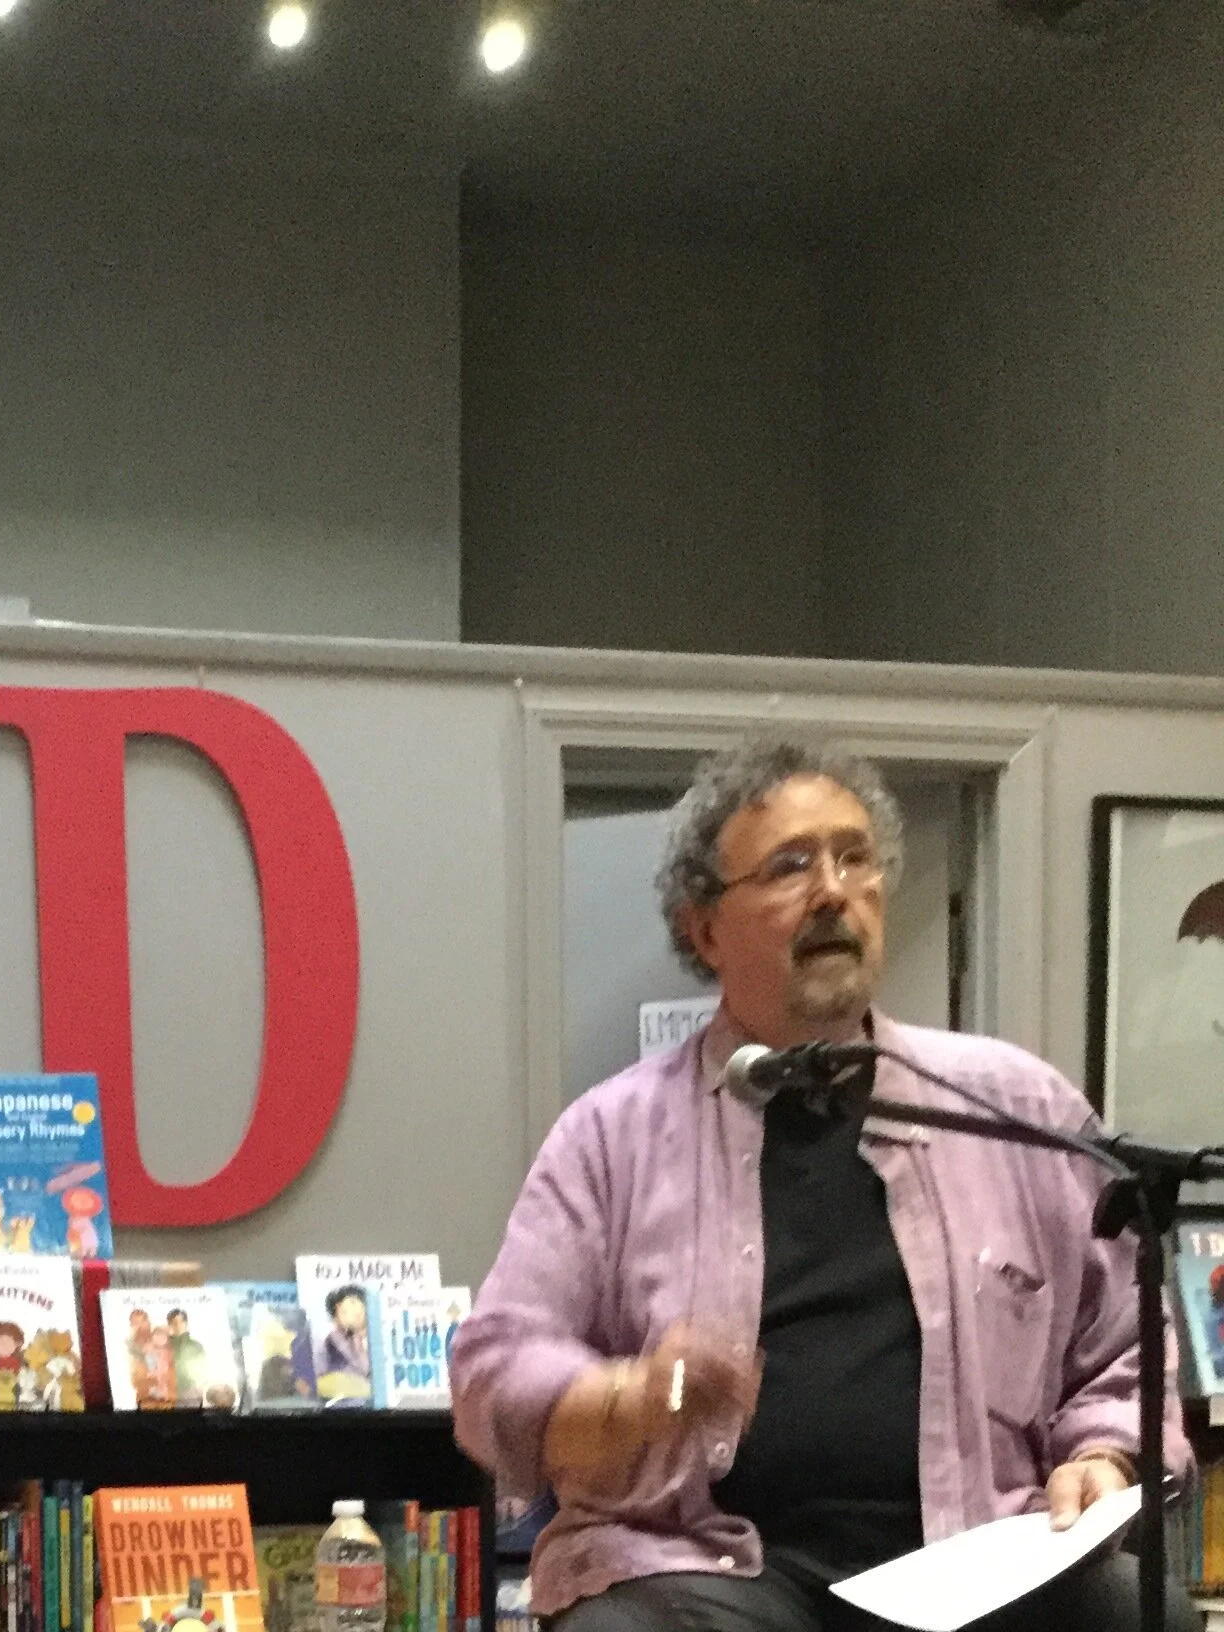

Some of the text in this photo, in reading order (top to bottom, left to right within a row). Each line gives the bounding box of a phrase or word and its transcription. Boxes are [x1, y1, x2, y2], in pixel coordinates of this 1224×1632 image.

[29, 1119, 85, 1140] Rhymes
[110, 1493, 235, 1514] WENDALL THOMAS
[109, 1517, 244, 1552] DROWNED
[112, 1551, 251, 1598] UNDER
